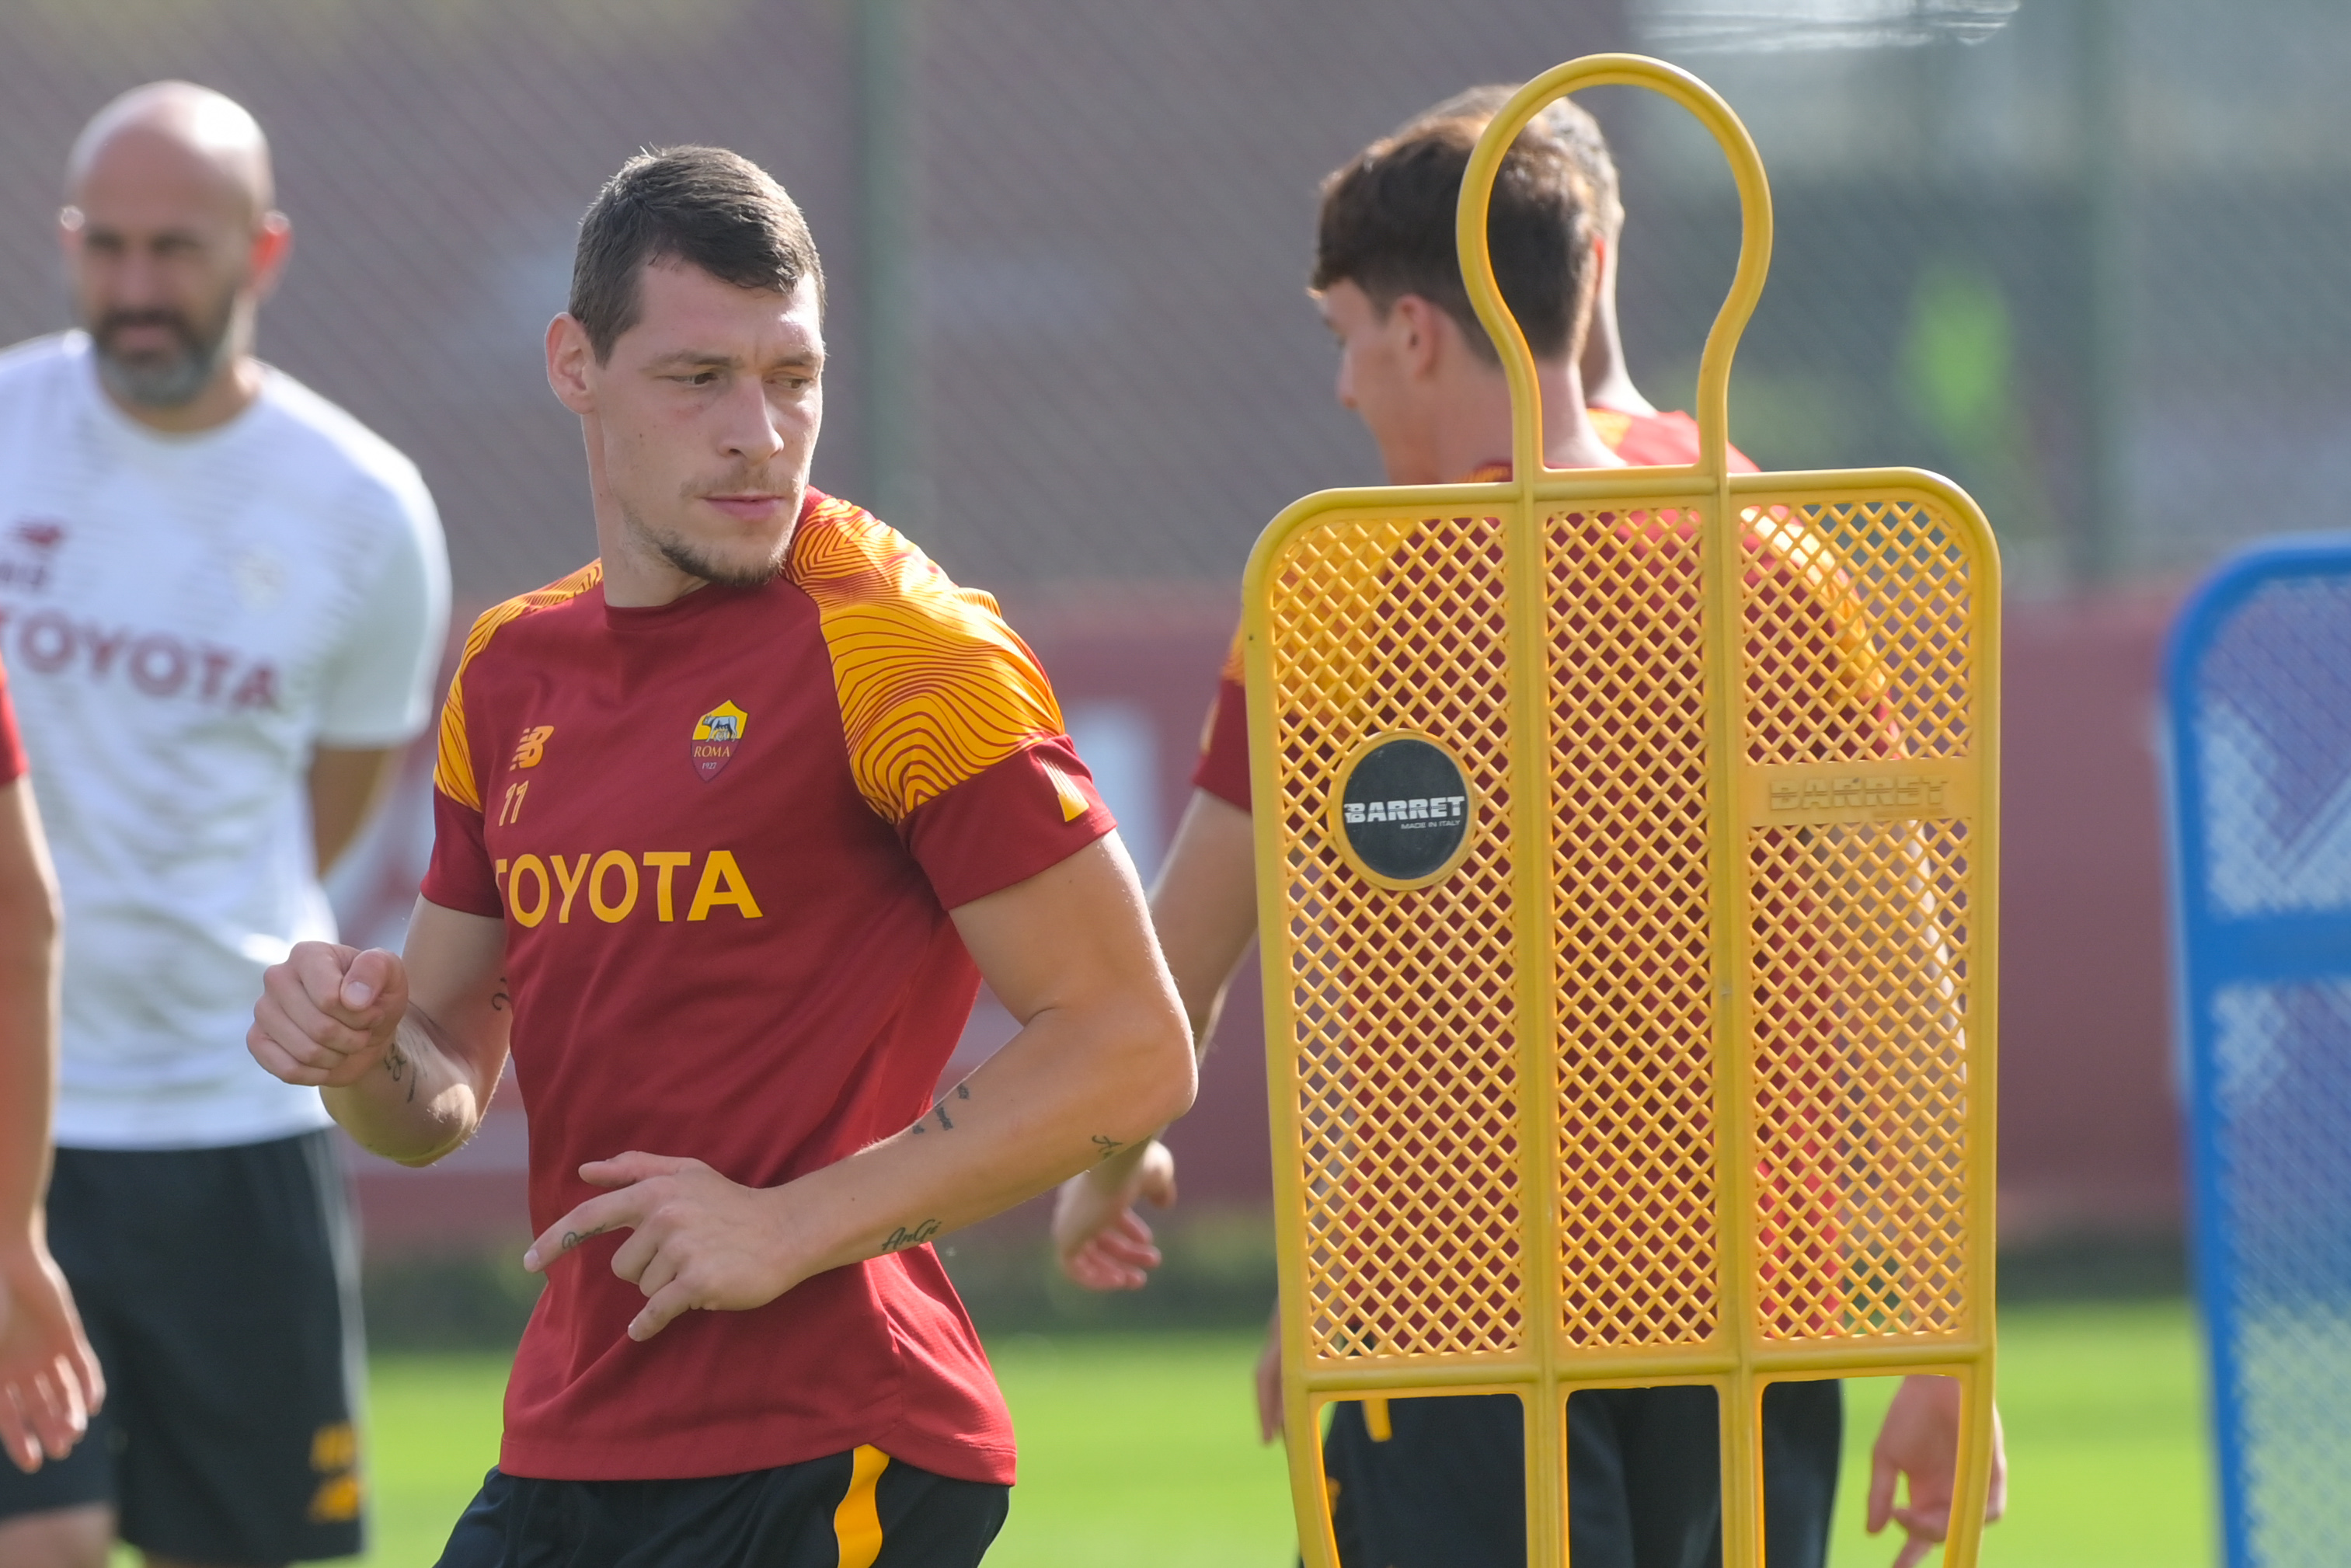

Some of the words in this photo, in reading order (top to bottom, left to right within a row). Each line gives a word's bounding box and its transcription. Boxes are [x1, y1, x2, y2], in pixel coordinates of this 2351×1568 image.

[694, 745, 730, 758] ROMA
[702, 761, 717, 770] 1927
[499, 779, 529, 827] 11
[1771, 776, 1949, 811] BARRET
[1343, 796, 1465, 824] BARRET
[1400, 821, 1426, 830] MADE
